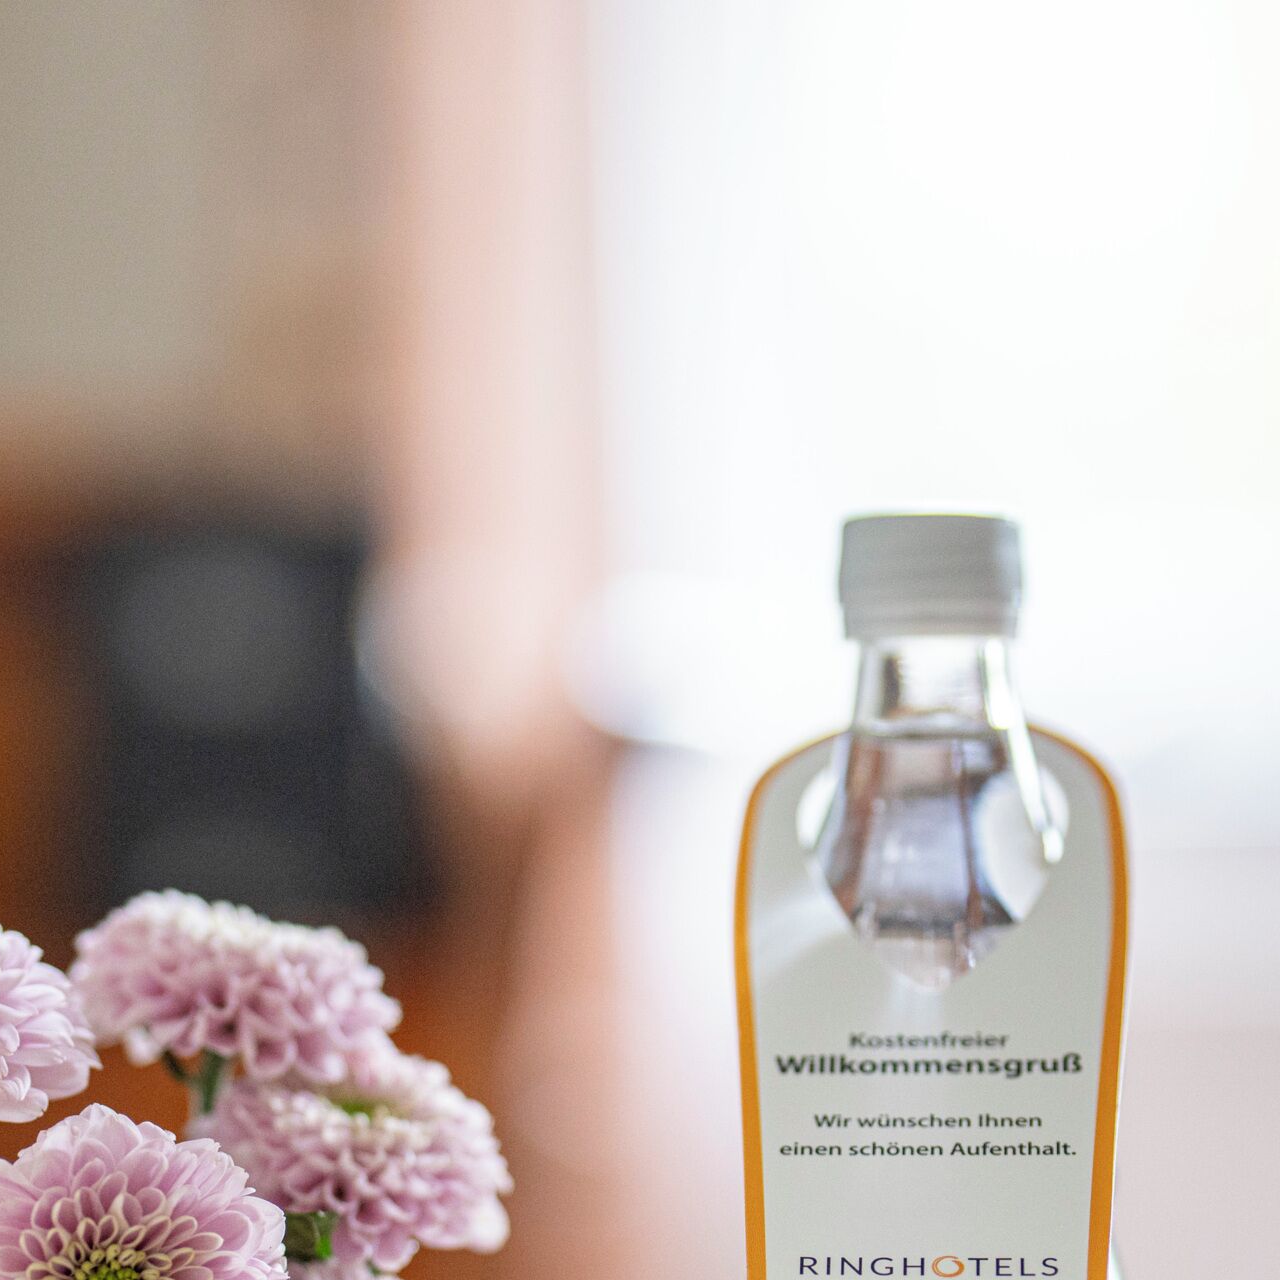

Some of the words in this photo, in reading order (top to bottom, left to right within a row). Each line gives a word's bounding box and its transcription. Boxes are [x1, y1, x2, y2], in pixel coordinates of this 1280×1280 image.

[849, 1031, 1010, 1049] Kostenfreier
[776, 1053, 1083, 1078] Willkommensgruß
[814, 1113, 851, 1128] Wir
[858, 1113, 971, 1128] wünschen
[978, 1114, 1042, 1128] Ihnen
[780, 1143, 842, 1156] einen
[849, 1141, 943, 1156] schönen
[950, 1141, 1077, 1156] Aufenthalt.
[799, 1255, 1059, 1278] RINGHOTELS
